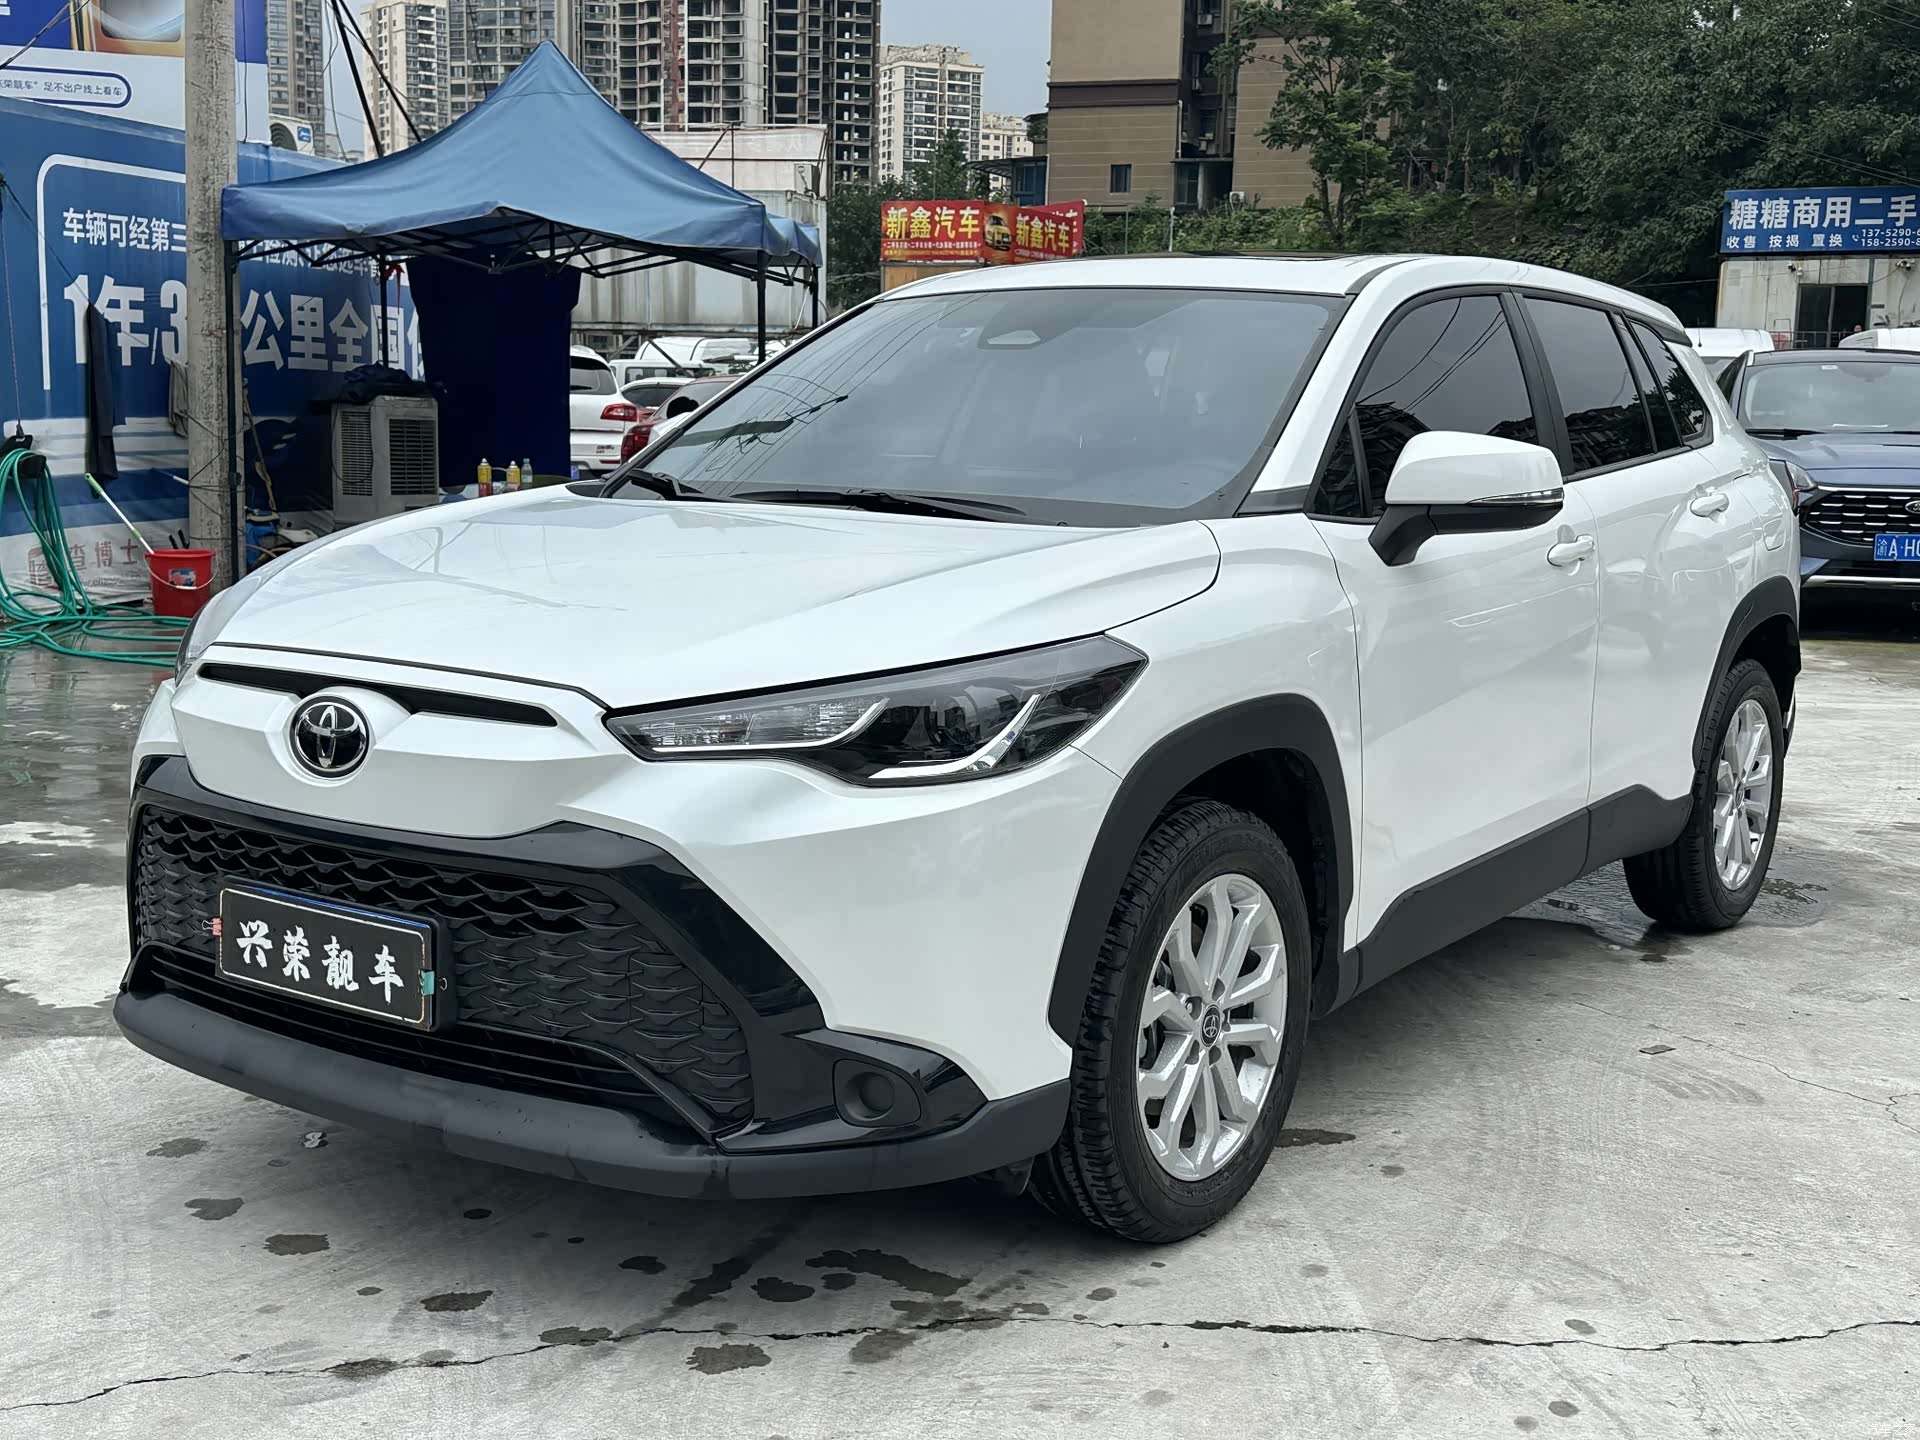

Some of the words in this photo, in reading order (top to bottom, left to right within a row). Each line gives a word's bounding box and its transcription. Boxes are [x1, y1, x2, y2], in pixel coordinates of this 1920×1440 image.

[886, 206, 980, 239] 新鑫汽车
[1728, 195, 1917, 230] 糖糖商用二手
[1016, 213, 1070, 253] 新鑫汽车
[1727, 236, 1756, 249] 收售
[1769, 235, 1799, 248] 按揭
[1812, 233, 1843, 247] 置换
[236, 919, 405, 1006] 兴荣靓车
